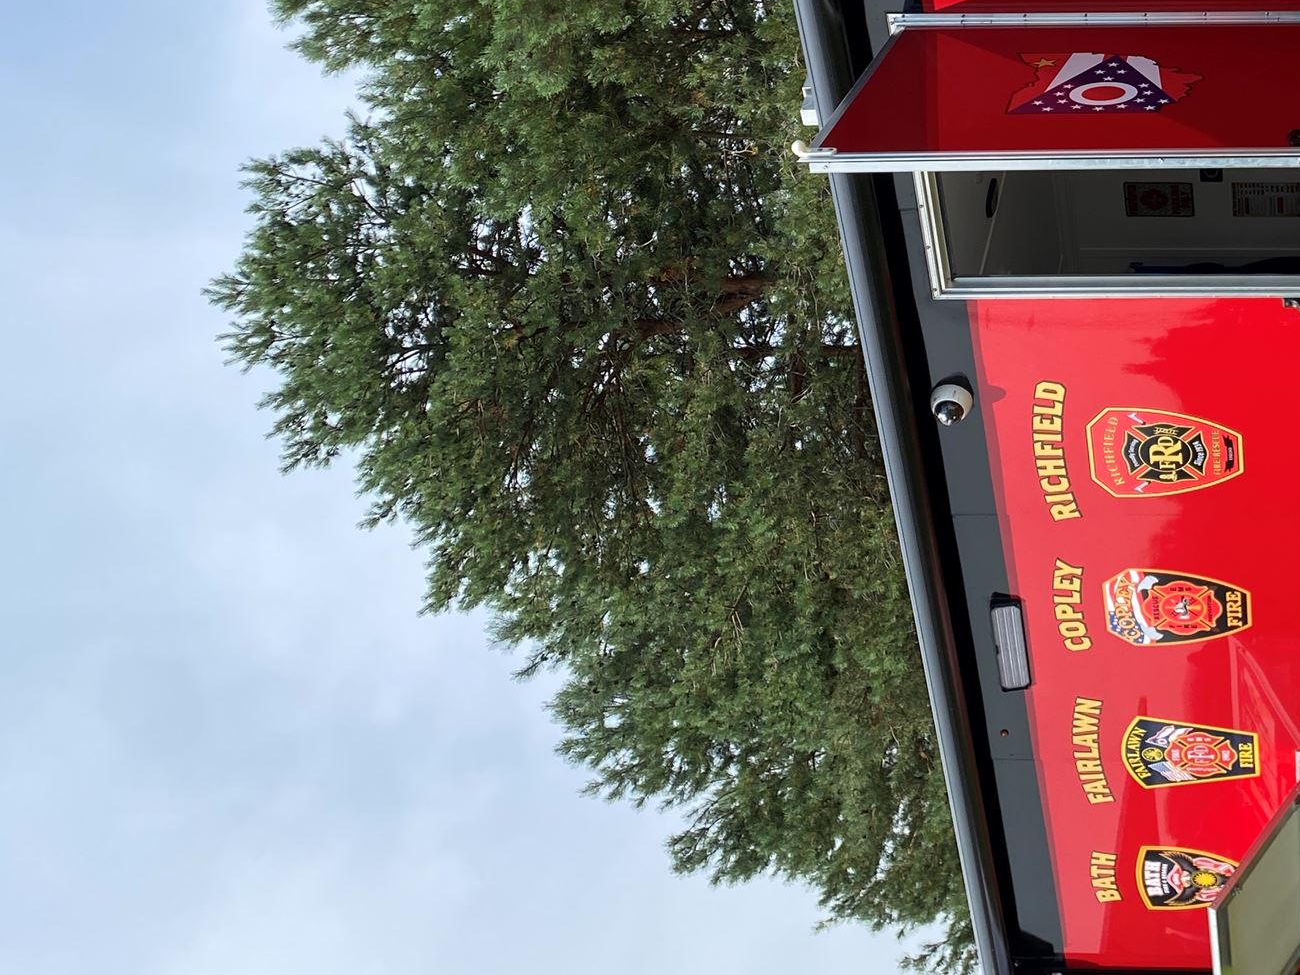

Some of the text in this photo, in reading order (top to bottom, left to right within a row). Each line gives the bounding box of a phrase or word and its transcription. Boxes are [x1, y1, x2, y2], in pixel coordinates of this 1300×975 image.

[1032, 381, 1082, 522] RICHFIELD
[1103, 417, 1125, 486] RICHFIELD
[1052, 558, 1092, 652] COPLEY
[1115, 576, 1141, 641] COPLEY
[1225, 591, 1242, 627] FIRE
[1072, 696, 1115, 805] FAIRLAWN
[1127, 726, 1152, 779] FAIRLAWN
[1238, 743, 1253, 768] FIRE
[1089, 850, 1123, 903] BATH
[1144, 860, 1165, 896] BATH
